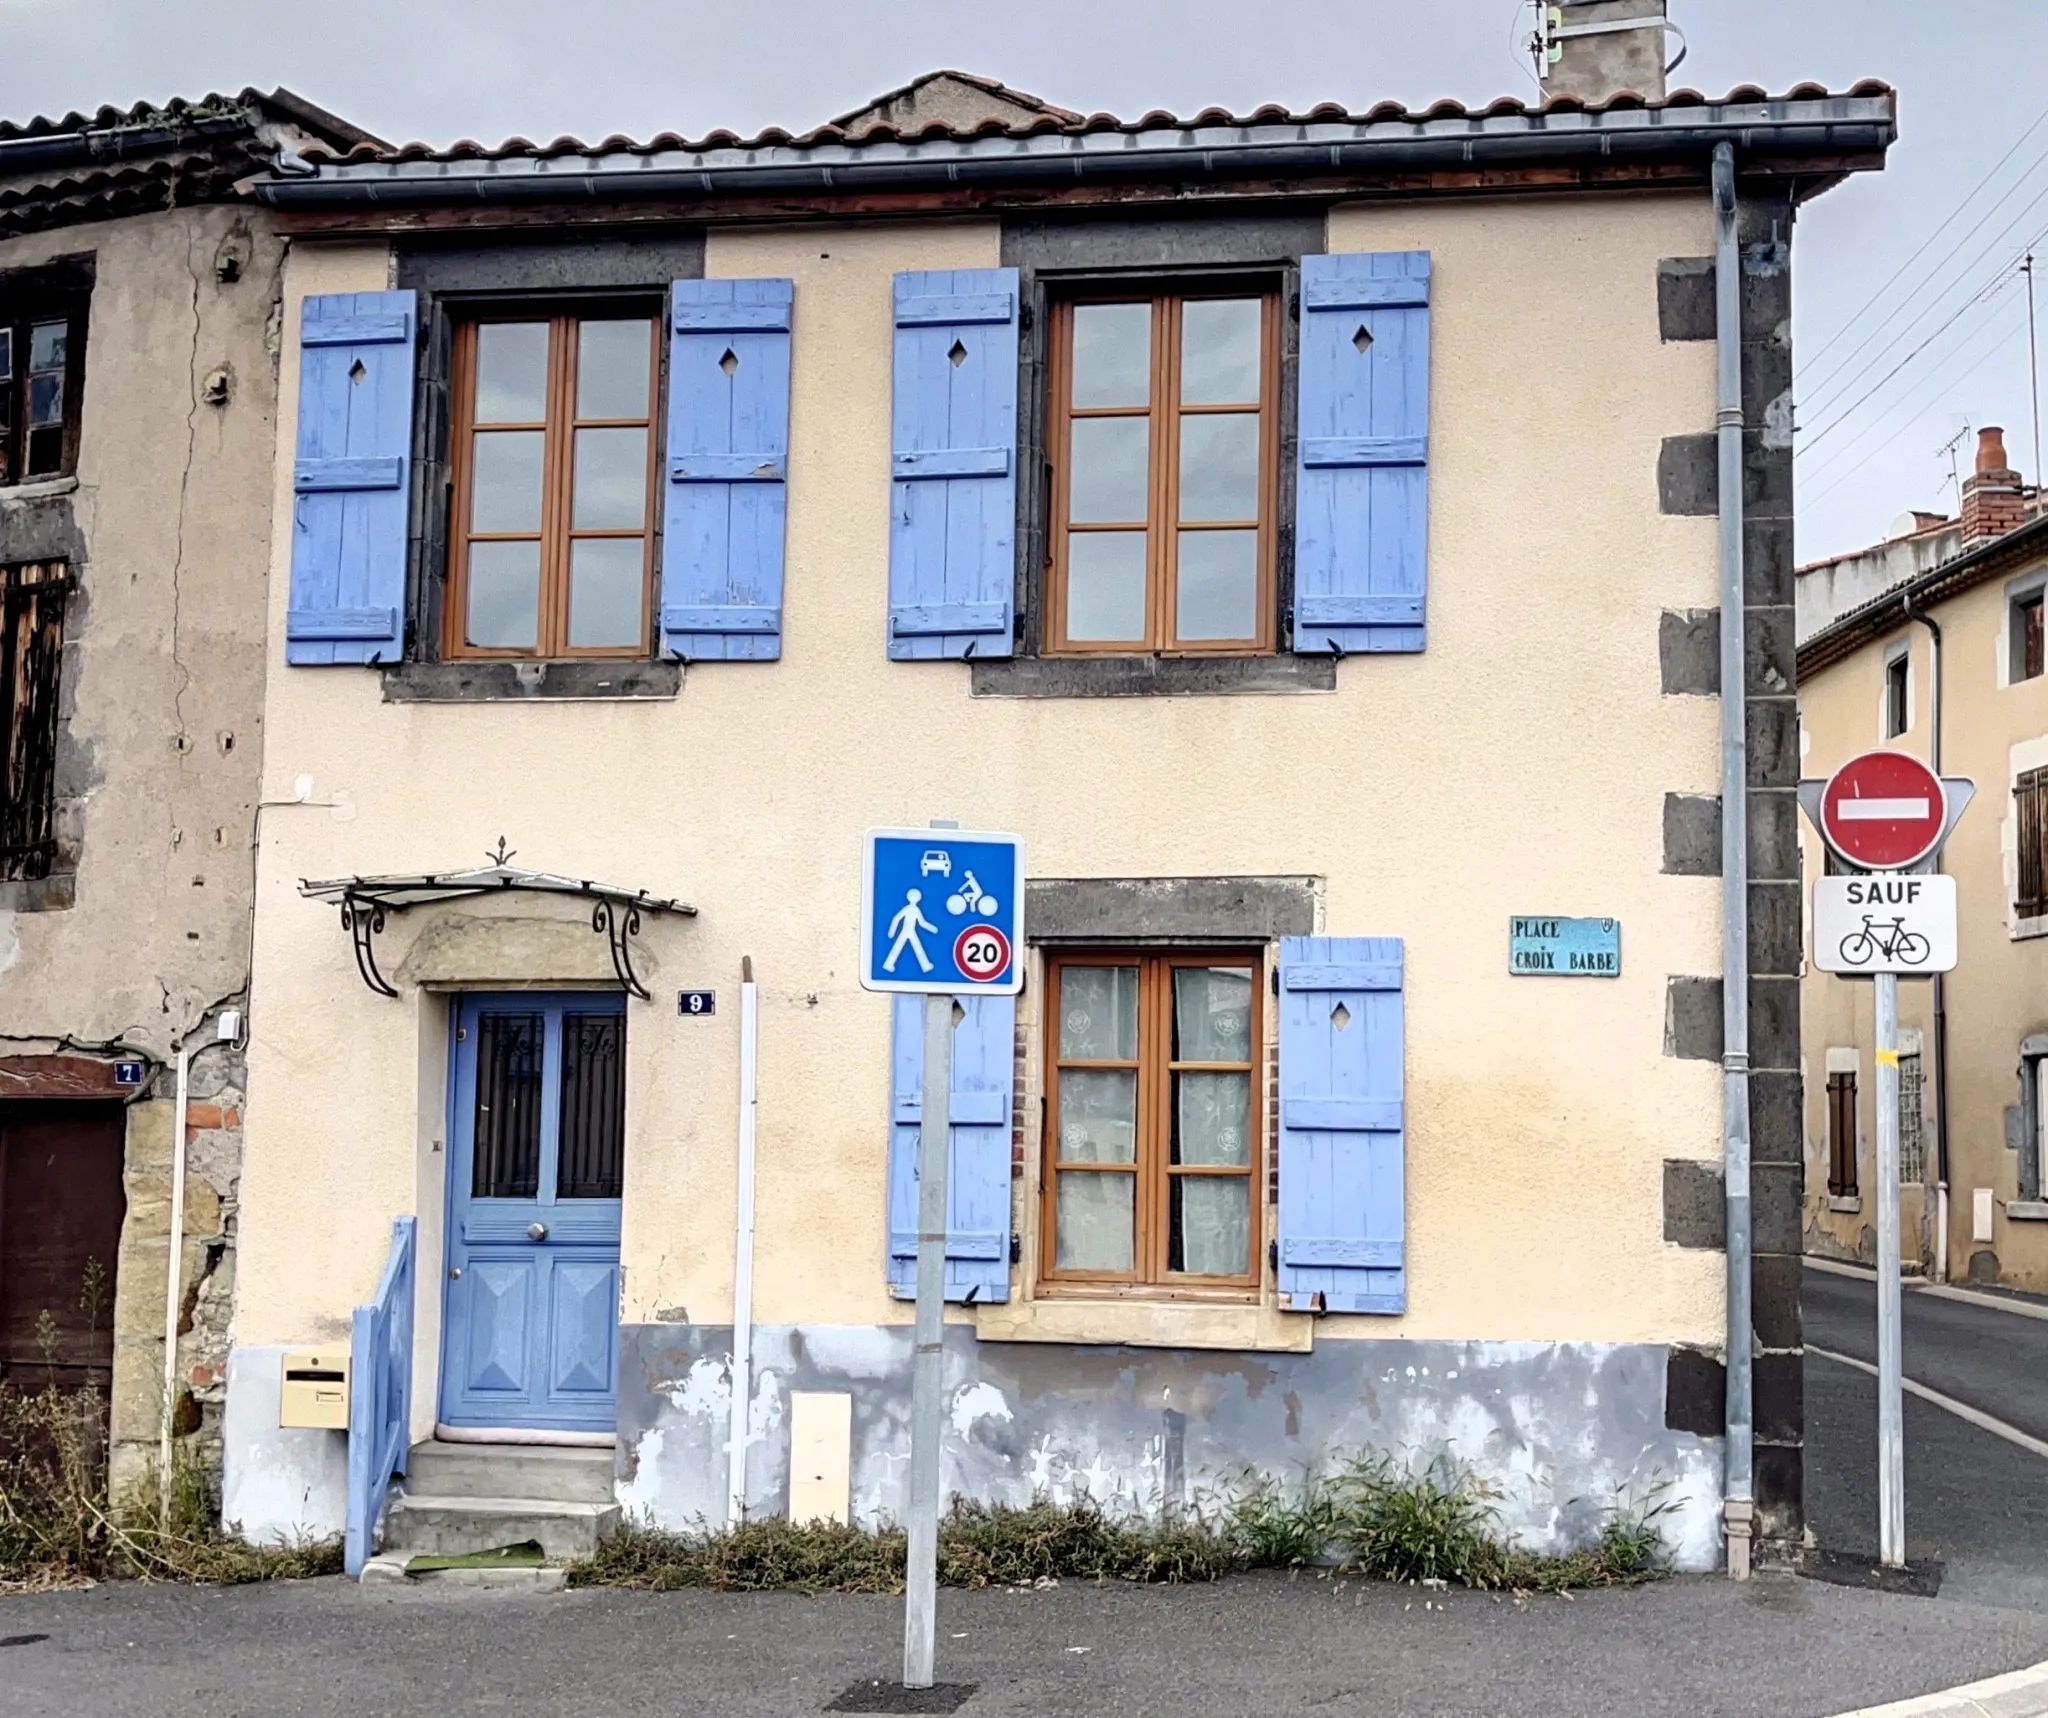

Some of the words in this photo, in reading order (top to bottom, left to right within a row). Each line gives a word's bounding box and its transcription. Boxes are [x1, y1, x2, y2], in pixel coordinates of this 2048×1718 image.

[1847, 882, 1921, 904] SAUF
[1515, 920, 1560, 938] PLACE
[967, 942, 998, 963] 20
[1569, 951, 1615, 970] BARBE
[689, 994, 703, 1012] 9
[122, 1064, 133, 1081] 7
